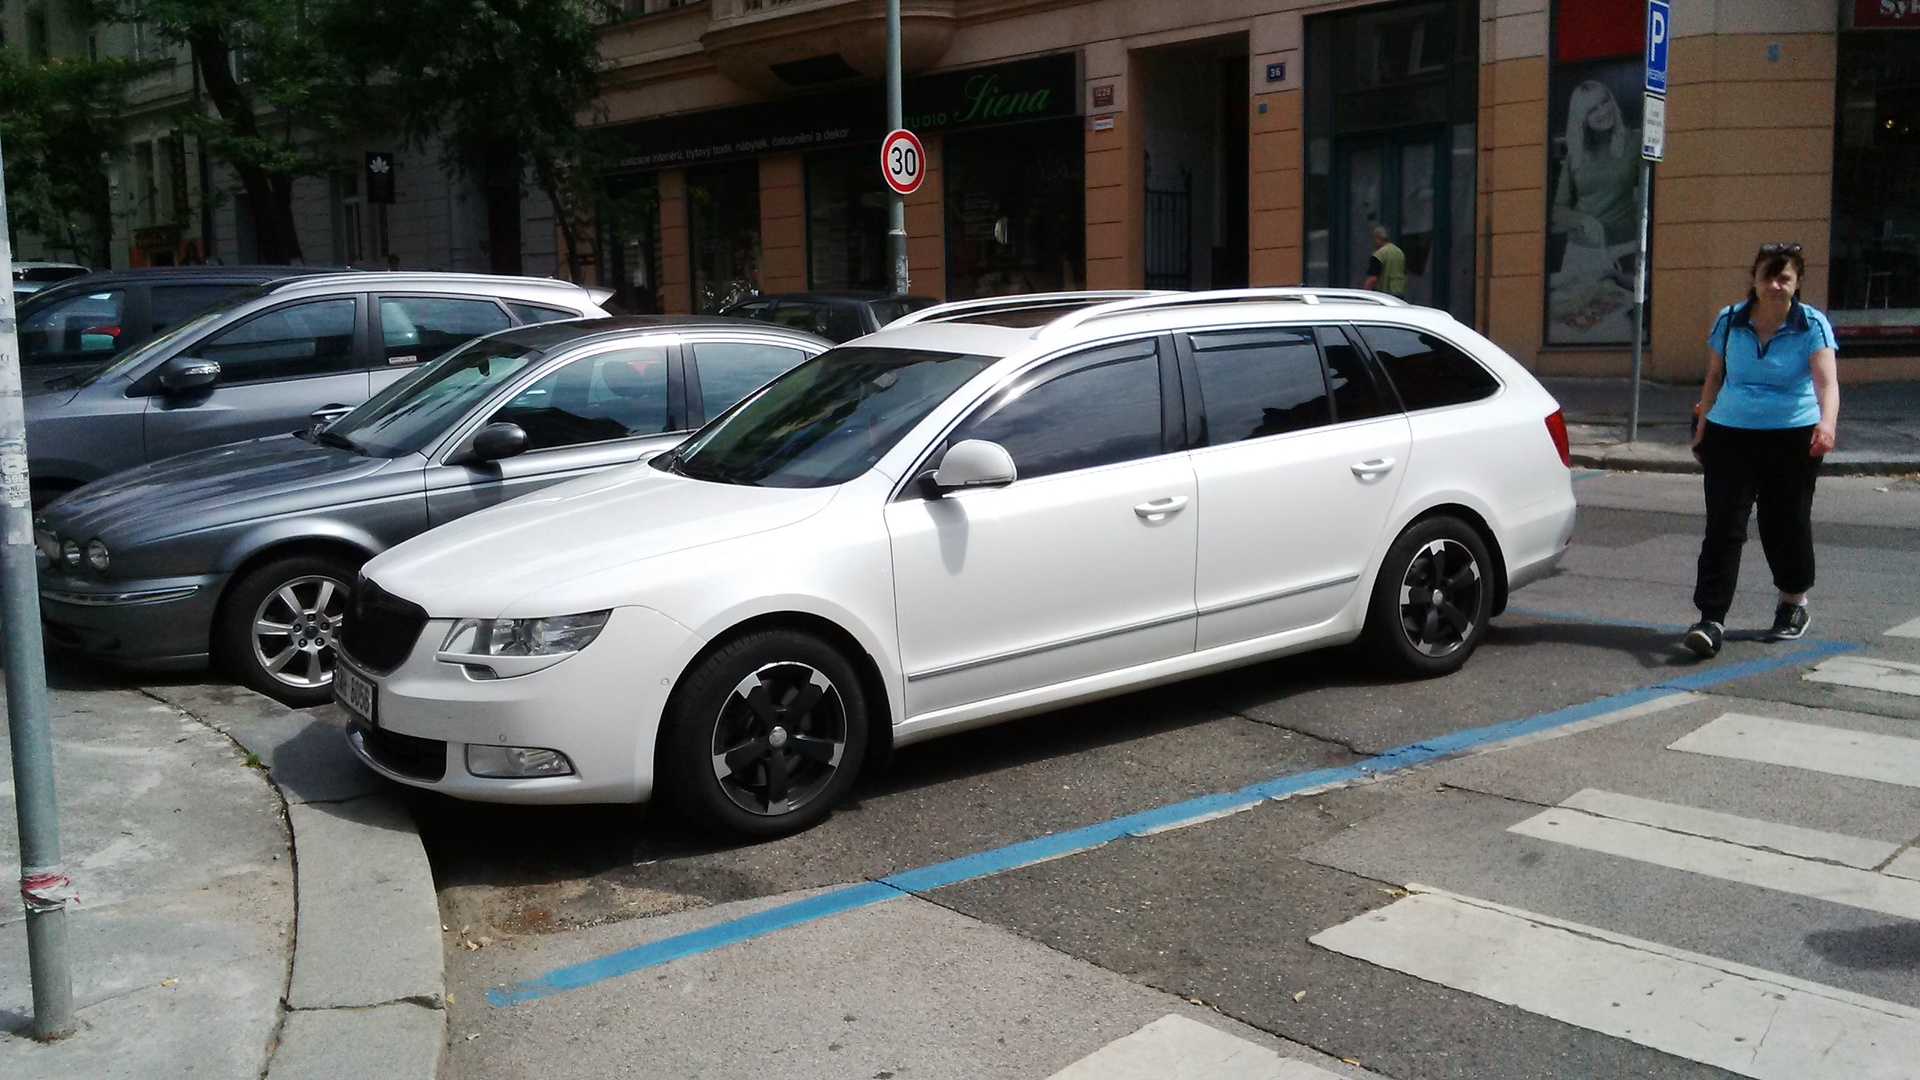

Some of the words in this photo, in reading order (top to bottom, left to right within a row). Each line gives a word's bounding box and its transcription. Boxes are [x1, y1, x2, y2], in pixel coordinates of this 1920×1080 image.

[1651, 11, 1664, 61] P
[1271, 68, 1280, 77] 36
[903, 113, 948, 129] TUDIO
[953, 74, 1052, 123] Siena
[815, 132, 822, 141] a
[823, 127, 850, 140] dekor
[891, 146, 917, 177] 30
